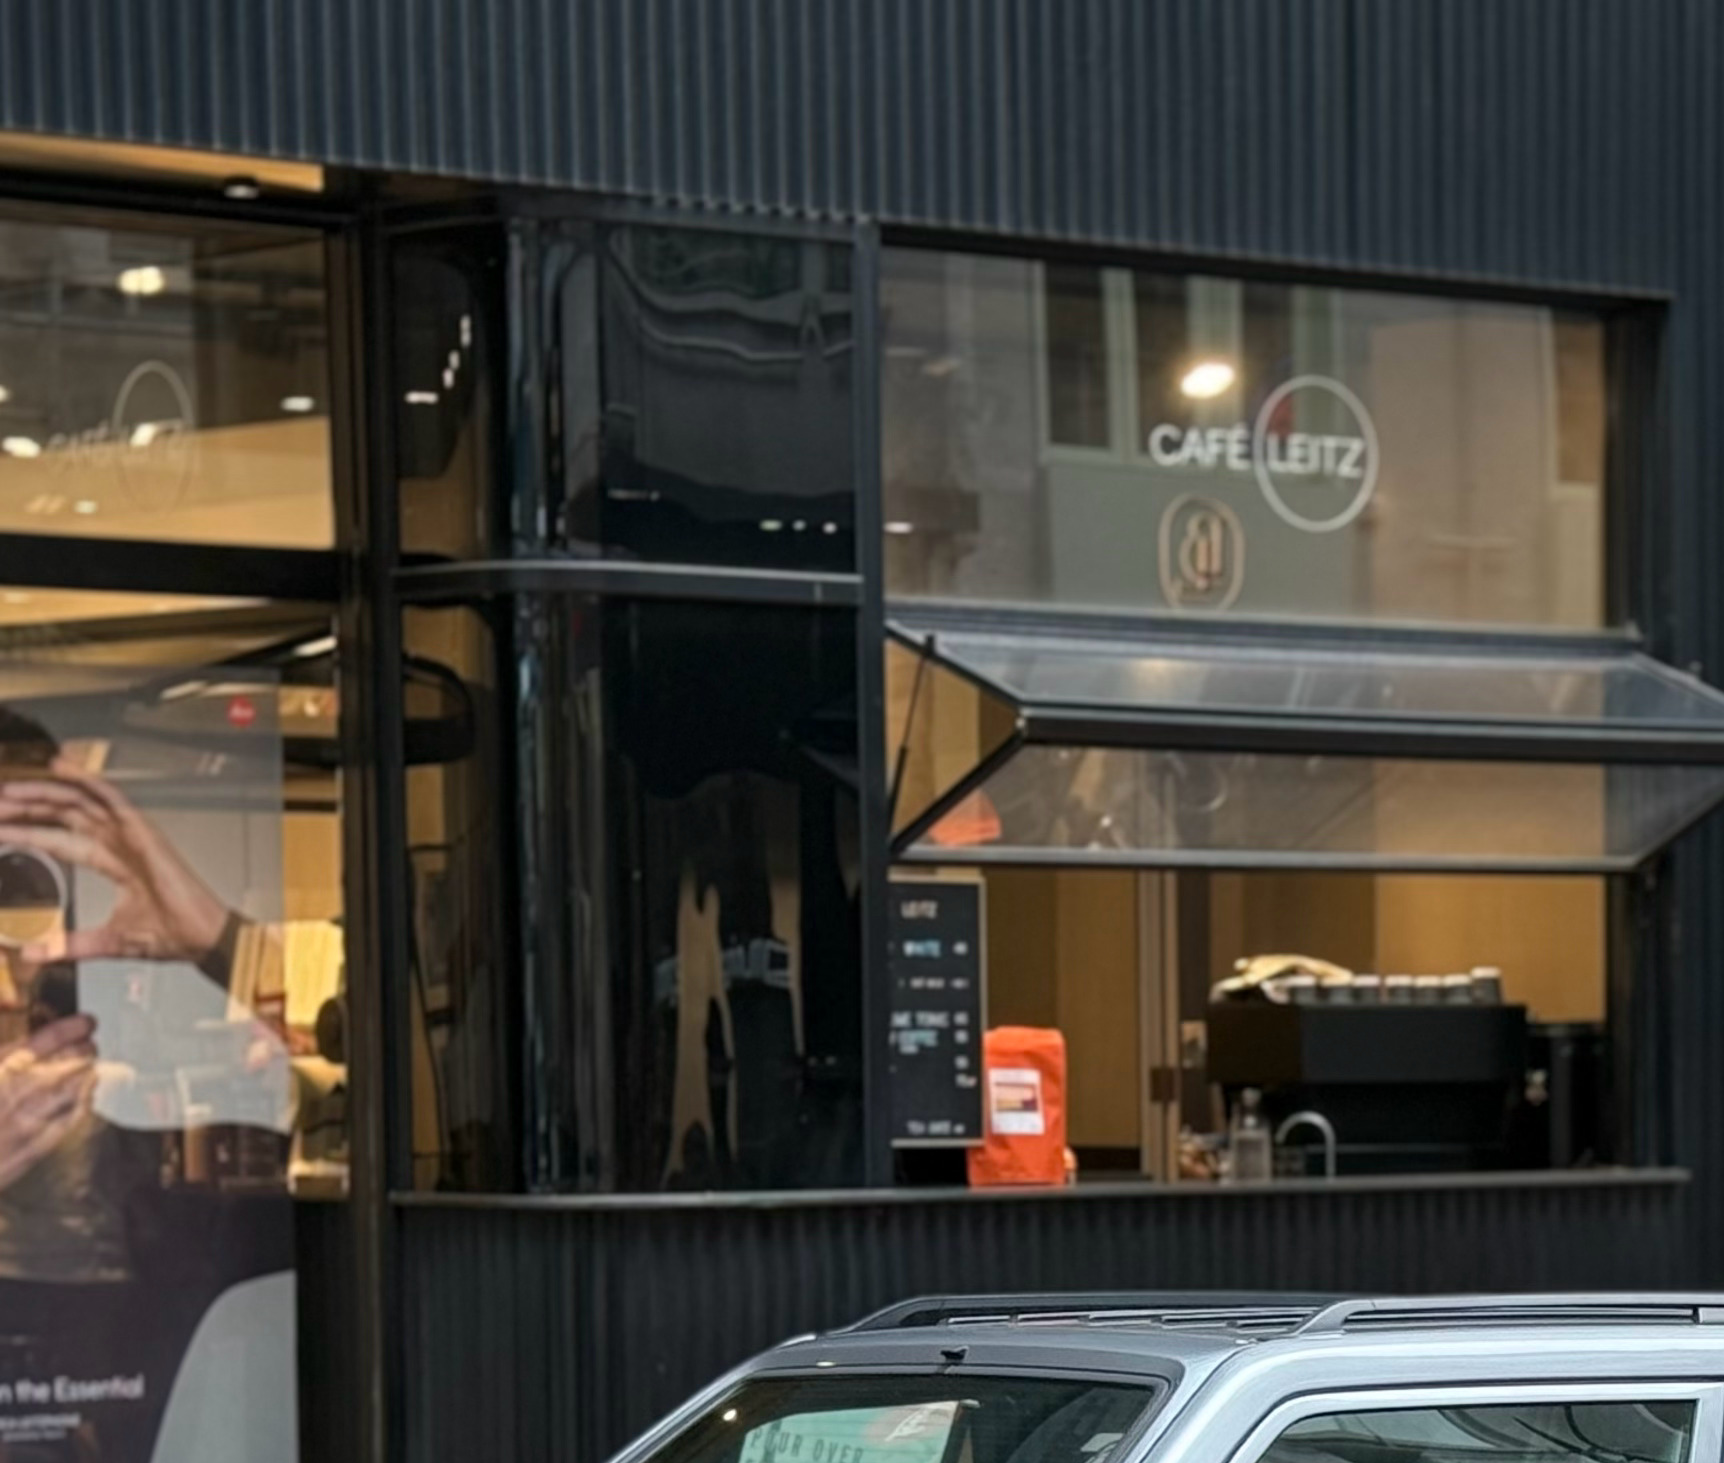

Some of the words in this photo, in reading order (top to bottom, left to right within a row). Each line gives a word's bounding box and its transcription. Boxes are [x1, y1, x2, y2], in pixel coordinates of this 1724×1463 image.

[1149, 422, 1252, 470] CAFÉ
[1266, 432, 1366, 479] LEITZ
[53, 1373, 145, 1402] Essential
[751, 1428, 804, 1457] POUR
